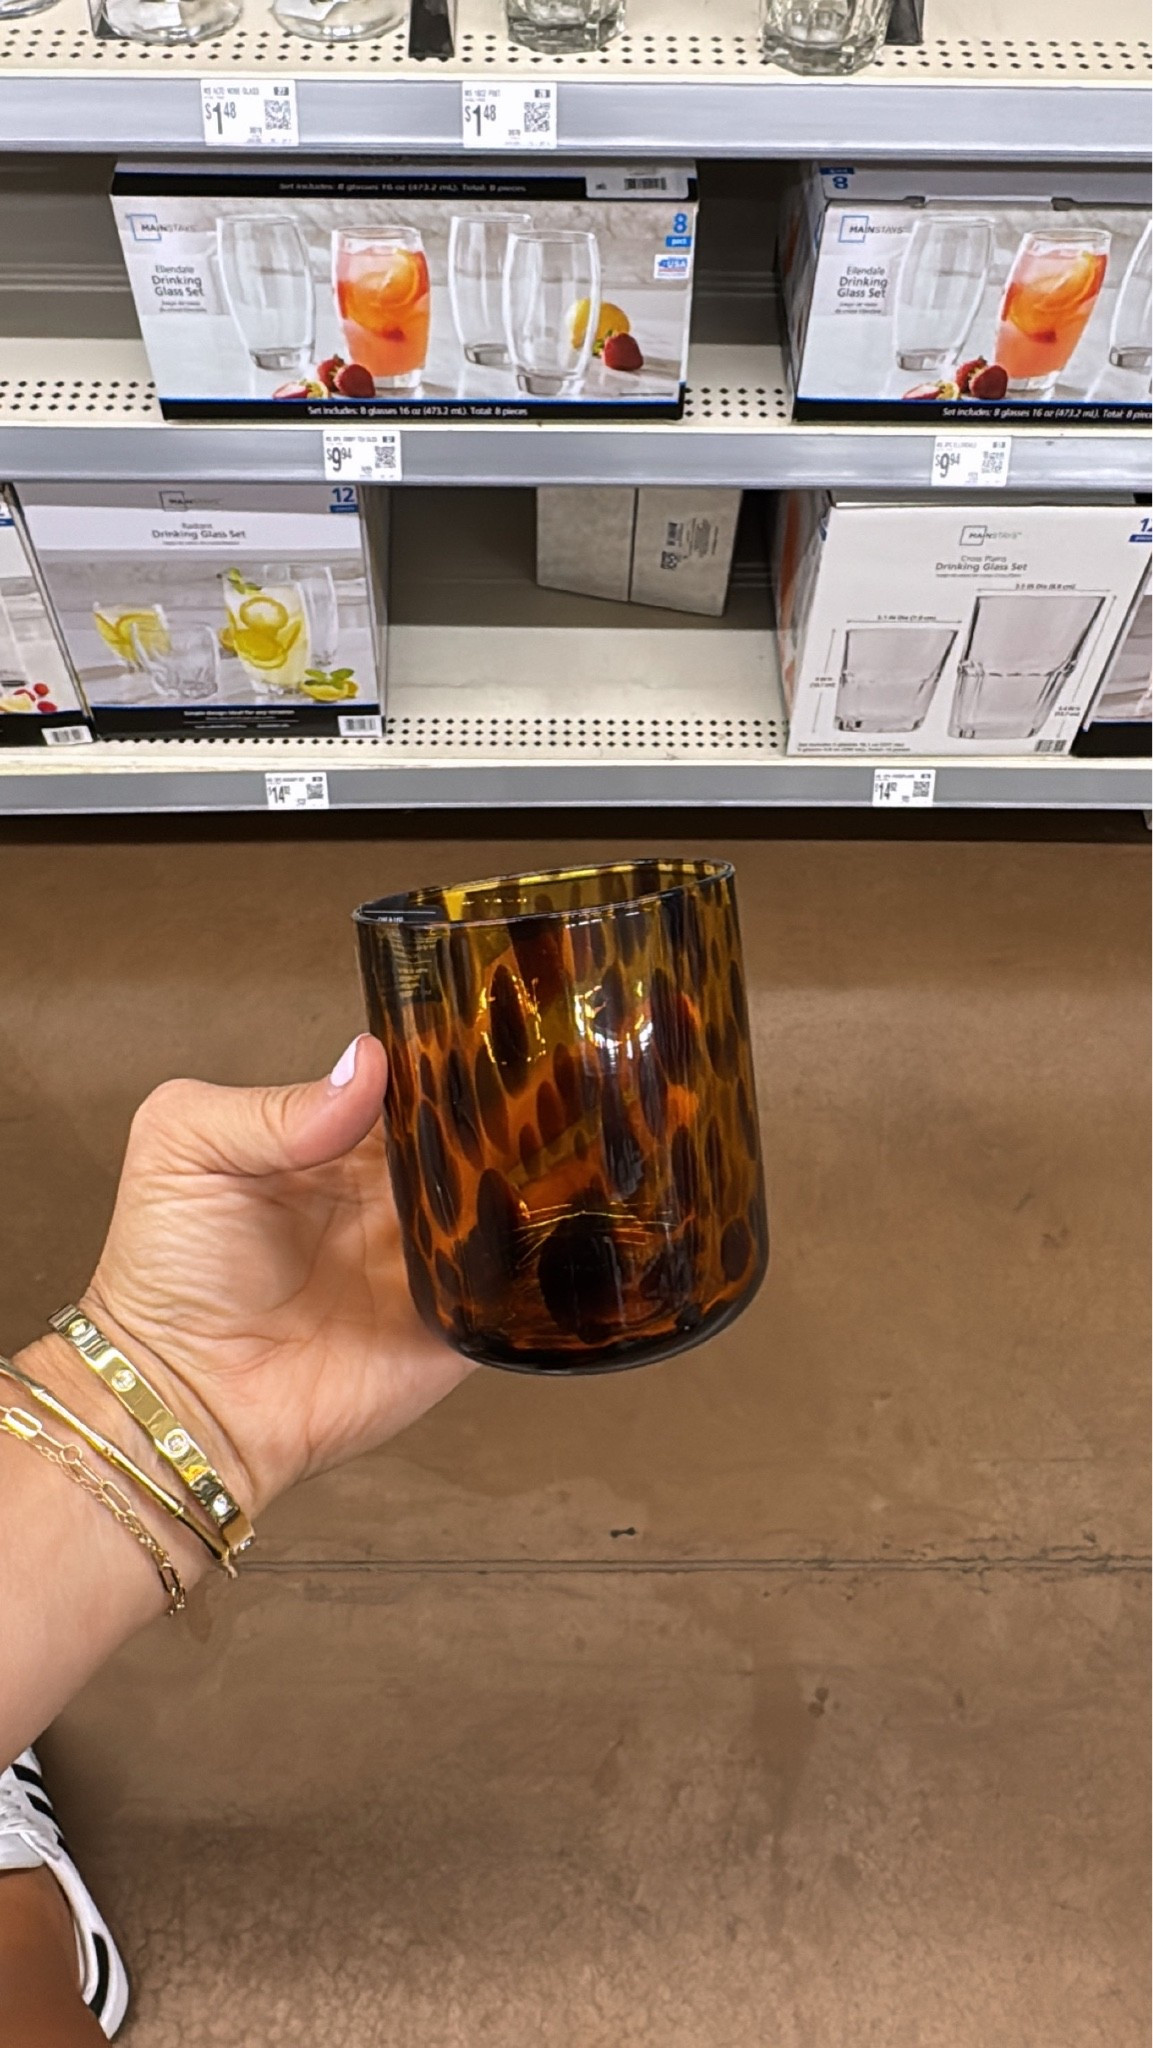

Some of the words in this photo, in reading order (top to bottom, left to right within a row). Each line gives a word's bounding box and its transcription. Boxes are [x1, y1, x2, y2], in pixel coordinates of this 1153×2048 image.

[832, 176, 848, 189] 8
[673, 212, 688, 233] 8
[849, 225, 904, 234] MAINSTAYS
[846, 265, 885, 276] Ellendale
[151, 275, 202, 288] Drinking
[839, 276, 888, 289] Drinking
[154, 286, 184, 297] Glass
[185, 286, 205, 297] Set
[836, 288, 865, 298] Glass
[868, 288, 886, 298] Set
[307, 405, 322, 415] Set
[360, 406, 367, 415] 8
[368, 406, 397, 417] glasses
[399, 406, 410, 415] 16
[495, 406, 501, 415] 8
[502, 407, 528, 417] pieces
[942, 407, 956, 416] Set
[993, 407, 1000, 417] 8
[1001, 408, 1030, 419] glasses
[1032, 408, 1042, 417] 16
[1126, 409, 1133, 418] 8
[332, 486, 355, 503] 12
[1140, 518, 1152, 532] 1
[151, 529, 199, 541] Drinking
[200, 529, 228, 539] Glass
[229, 529, 246, 538] Set
[935, 562, 980, 573] Drinking
[982, 562, 1009, 571] Glass
[1011, 562, 1028, 571] Set
